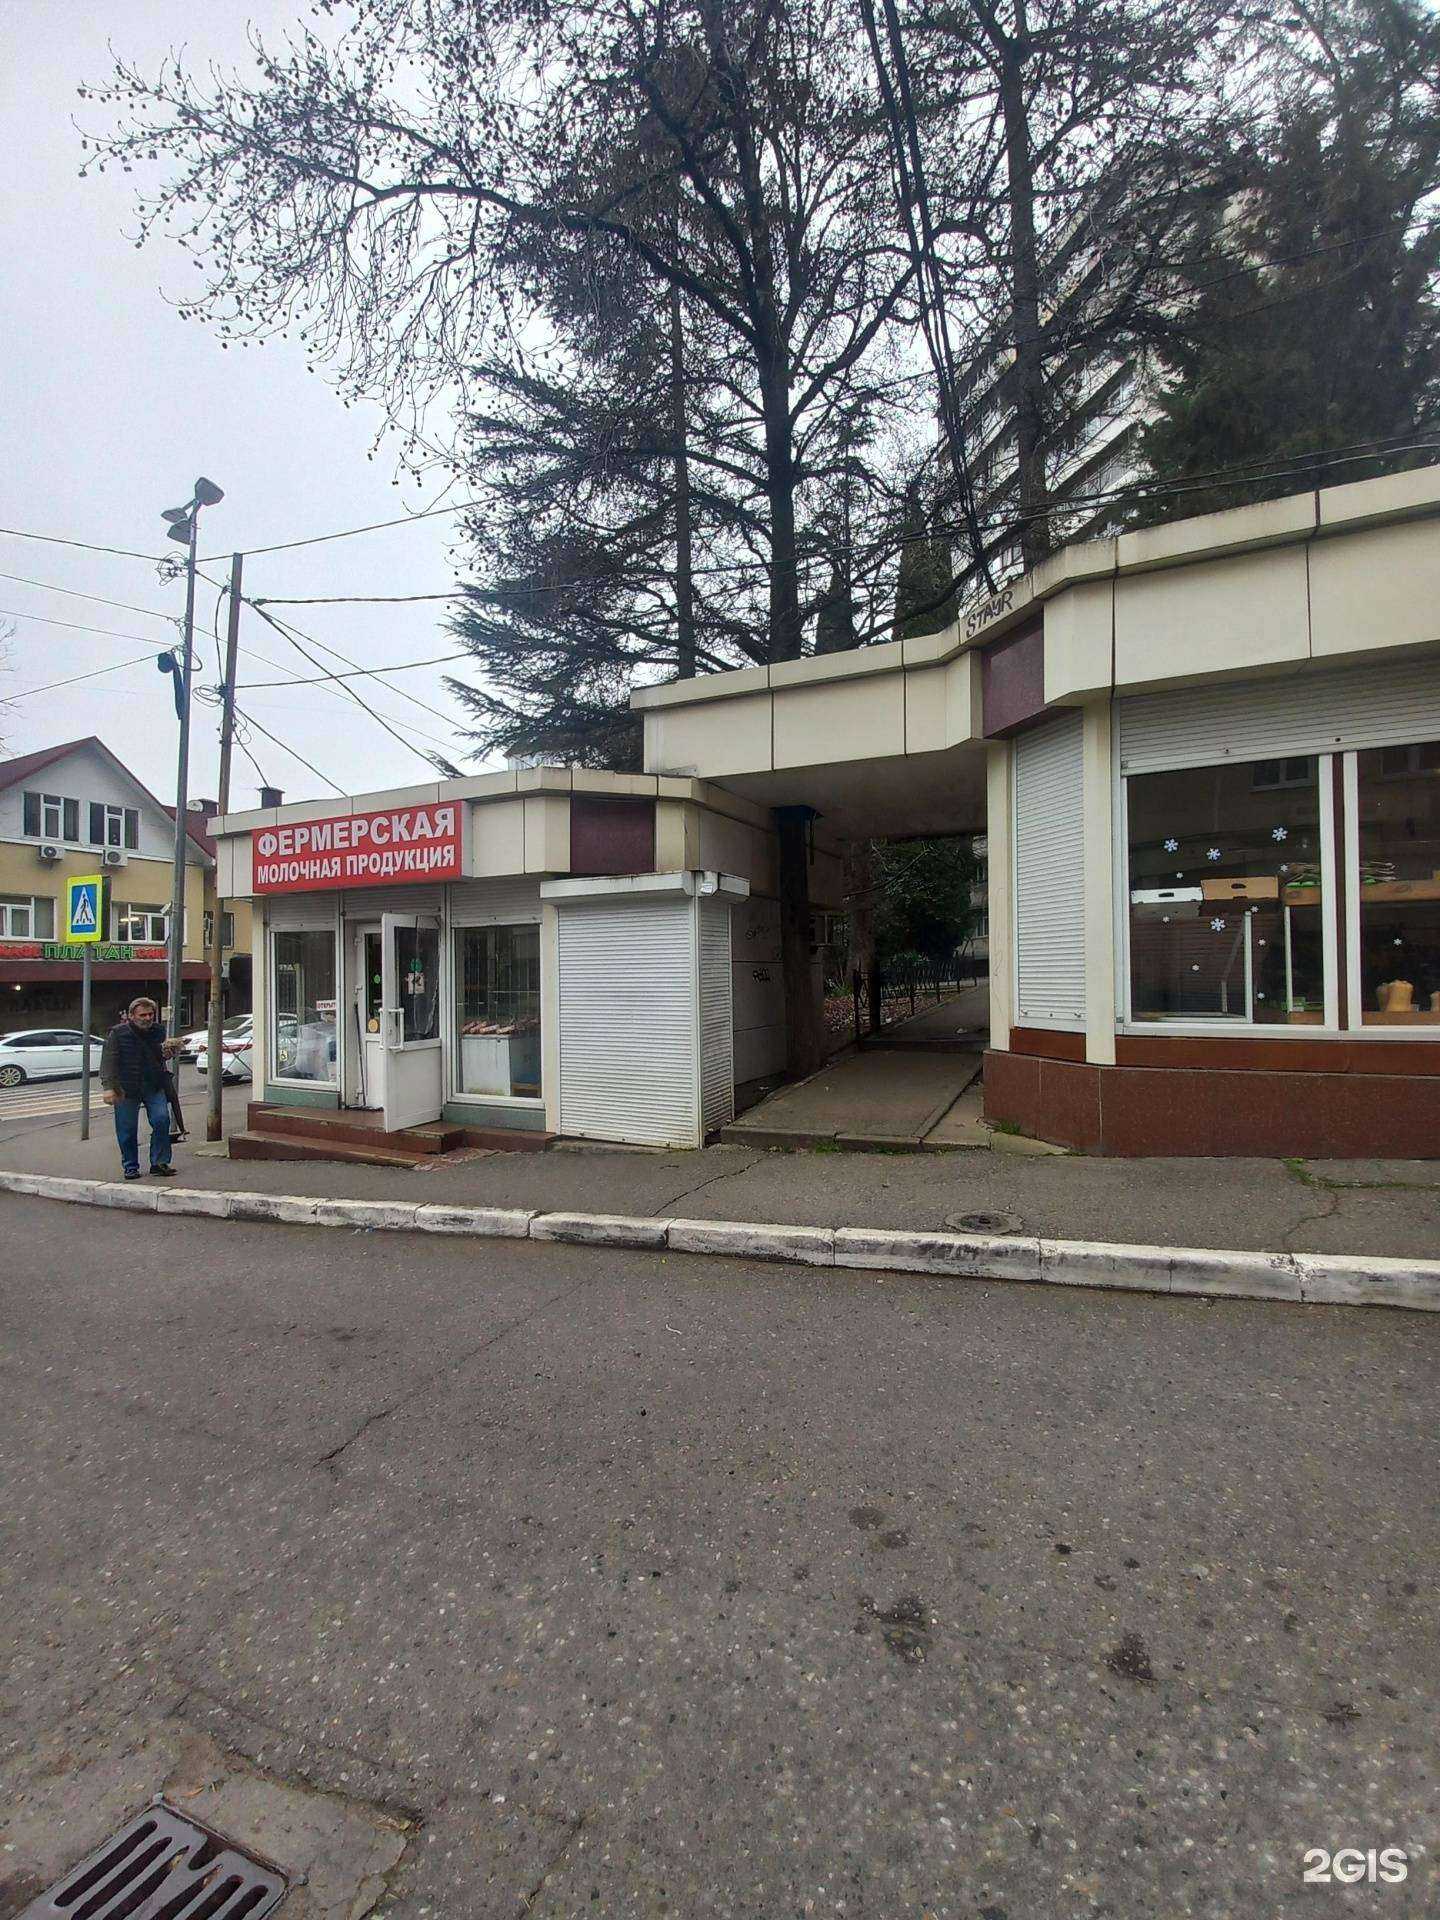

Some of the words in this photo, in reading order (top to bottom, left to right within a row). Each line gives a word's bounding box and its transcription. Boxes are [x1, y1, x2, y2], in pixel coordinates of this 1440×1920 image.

[258, 807, 456, 858] ФЕРМЕРСКАЯ
[257, 857, 341, 884] МОЛОЧНАЯ
[346, 845, 455, 877] ПРОДУКЦИЯ
